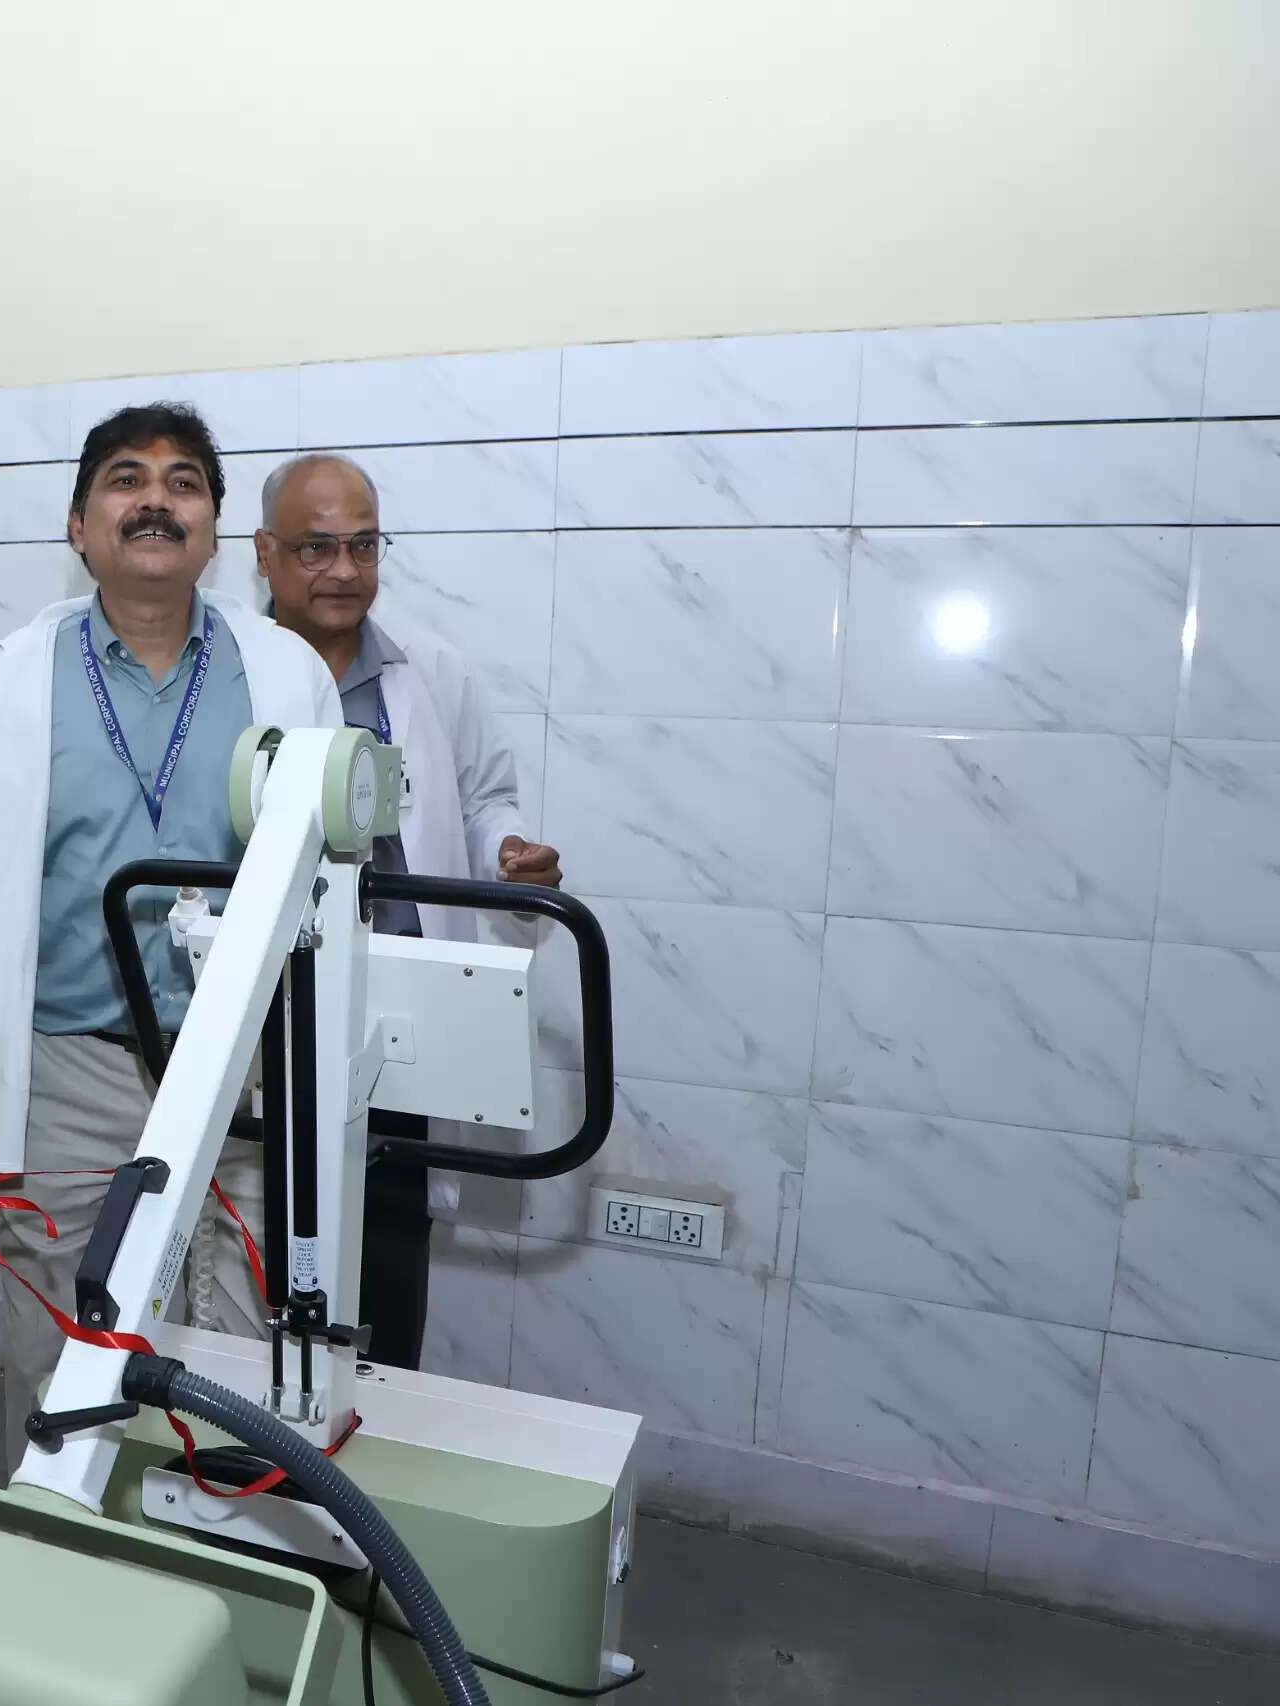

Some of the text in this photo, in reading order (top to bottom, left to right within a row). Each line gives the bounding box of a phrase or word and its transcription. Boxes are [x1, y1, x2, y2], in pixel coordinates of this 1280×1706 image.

[84, 655, 93, 667] OF
[87, 666, 115, 731] CORPORATION
[160, 629, 213, 788] MUNICIPAL CORPORATION OF DELHI
